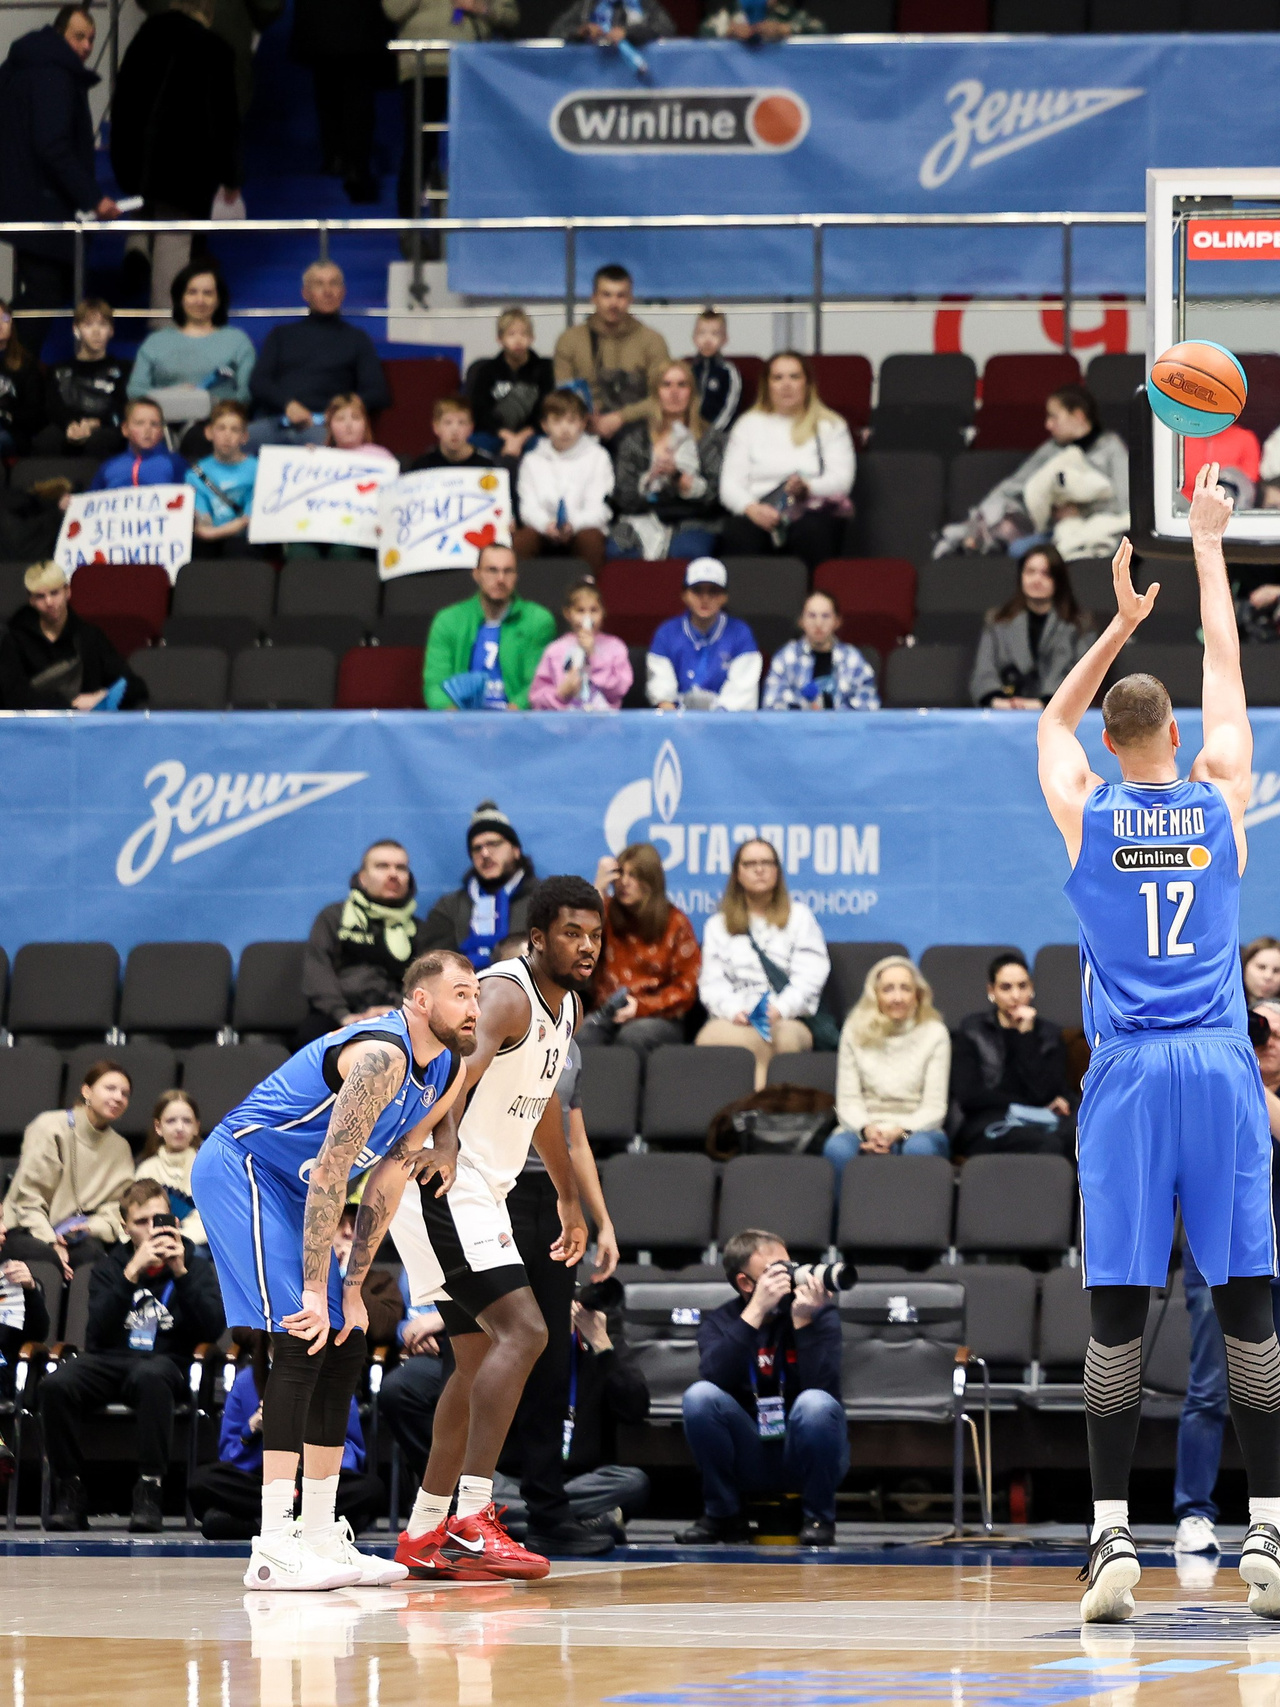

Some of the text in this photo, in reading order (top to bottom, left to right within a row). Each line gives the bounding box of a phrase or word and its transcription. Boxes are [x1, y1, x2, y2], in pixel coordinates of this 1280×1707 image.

[574, 103, 738, 140] Winline
[1113, 807, 1205, 837] KLIMENKO
[1121, 851, 1184, 865] Winline
[1138, 880, 1197, 958] 12
[539, 1048, 560, 1080] 13
